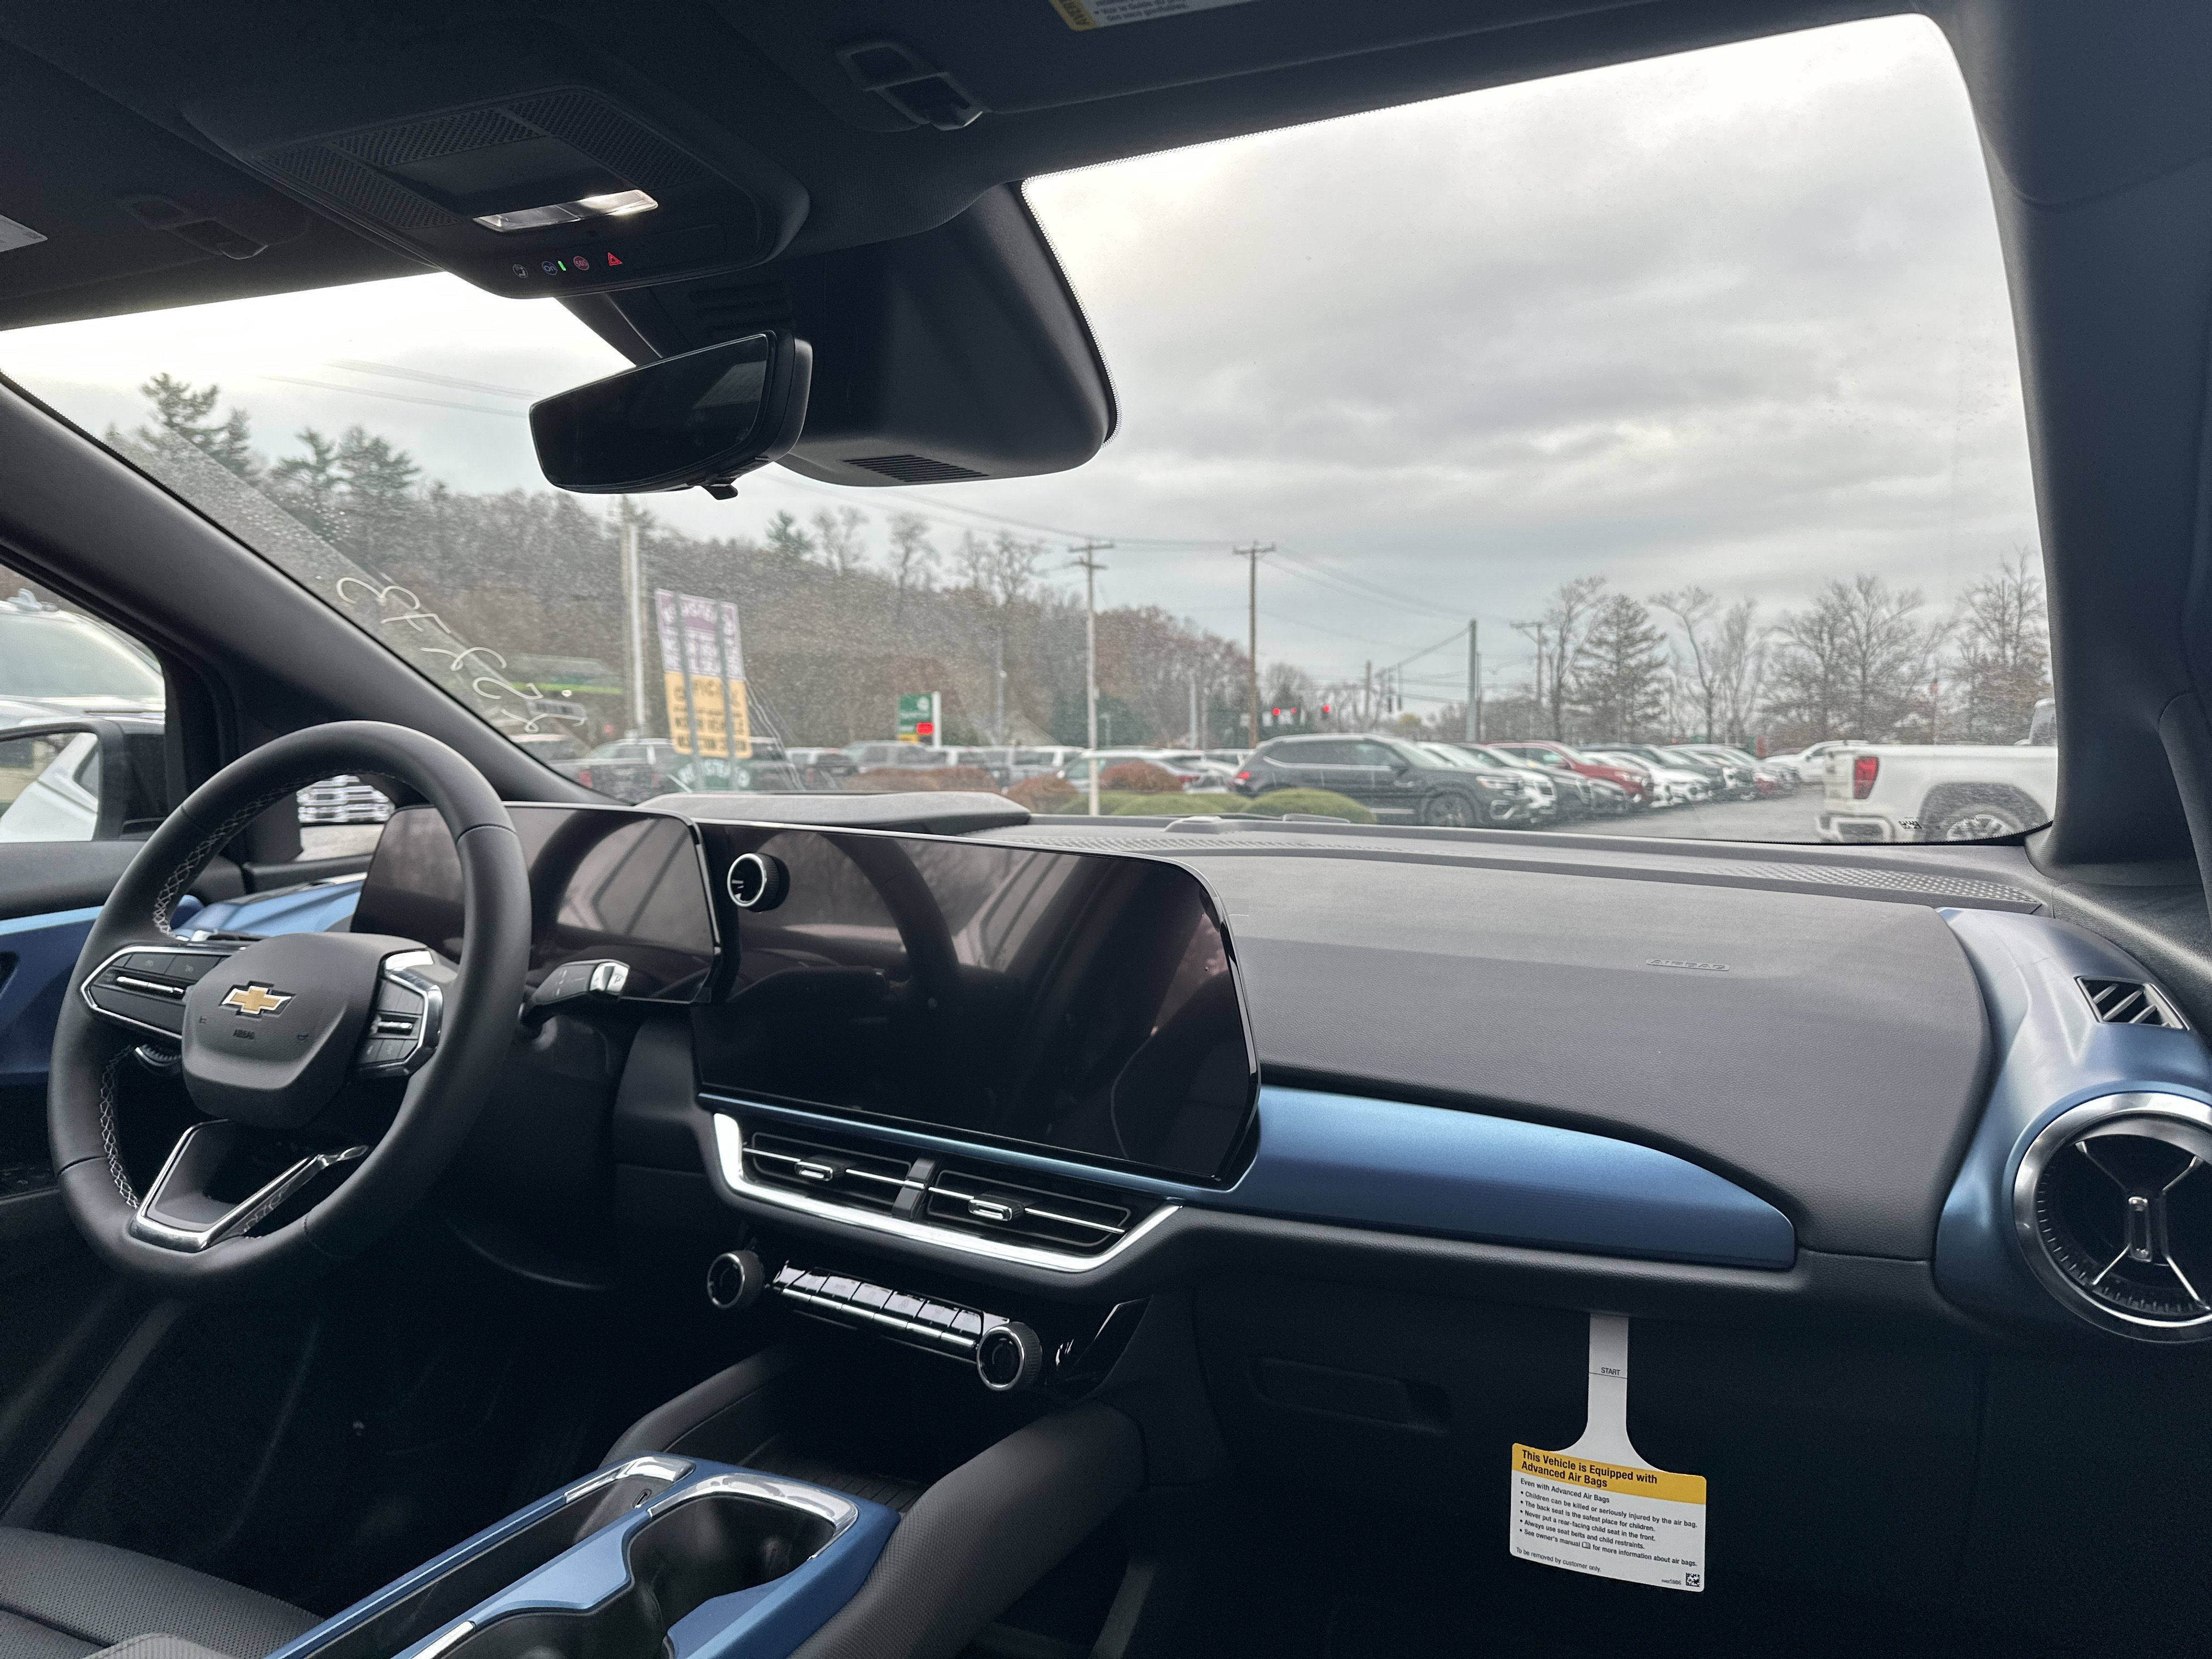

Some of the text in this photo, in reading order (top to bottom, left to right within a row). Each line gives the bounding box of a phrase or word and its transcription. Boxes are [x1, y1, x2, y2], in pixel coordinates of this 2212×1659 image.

[1651, 959, 1725, 969] AIRBAG
[1601, 1367, 1621, 1376] START
[1521, 1460, 1607, 1488] Advanced Air Bags
[1522, 1449, 1657, 1483] This Vehicle is Equipped with
[1520, 1477, 1535, 1487] Even
[1536, 1483, 1550, 1491] with
[1551, 1486, 1582, 1498] Advanced
[1594, 1494, 1610, 1503] Bags
[1525, 1491, 1550, 1502] Children
[1572, 1502, 1590, 1510] killed
[1599, 1508, 1627, 1518] seriously
[1628, 1511, 1651, 1521] injured
[1652, 1515, 1660, 1523] by
[1525, 1500, 1536, 1508] The
[1536, 1503, 1550, 1512] back
[1582, 1514, 1601, 1522] safest
[1524, 1519, 1544, 1530] Always
[1571, 1530, 1585, 1538] belts
[1525, 1509, 1541, 1519] Never
[1558, 1519, 1590, 1531] rear-facing
[1523, 1528, 1535, 1537] See
[1559, 1538, 1581, 1547] manual
[1618, 1549, 1652, 1560] information
[1531, 1552, 1554, 1562] removed
[1562, 1559, 1588, 1569] customer
